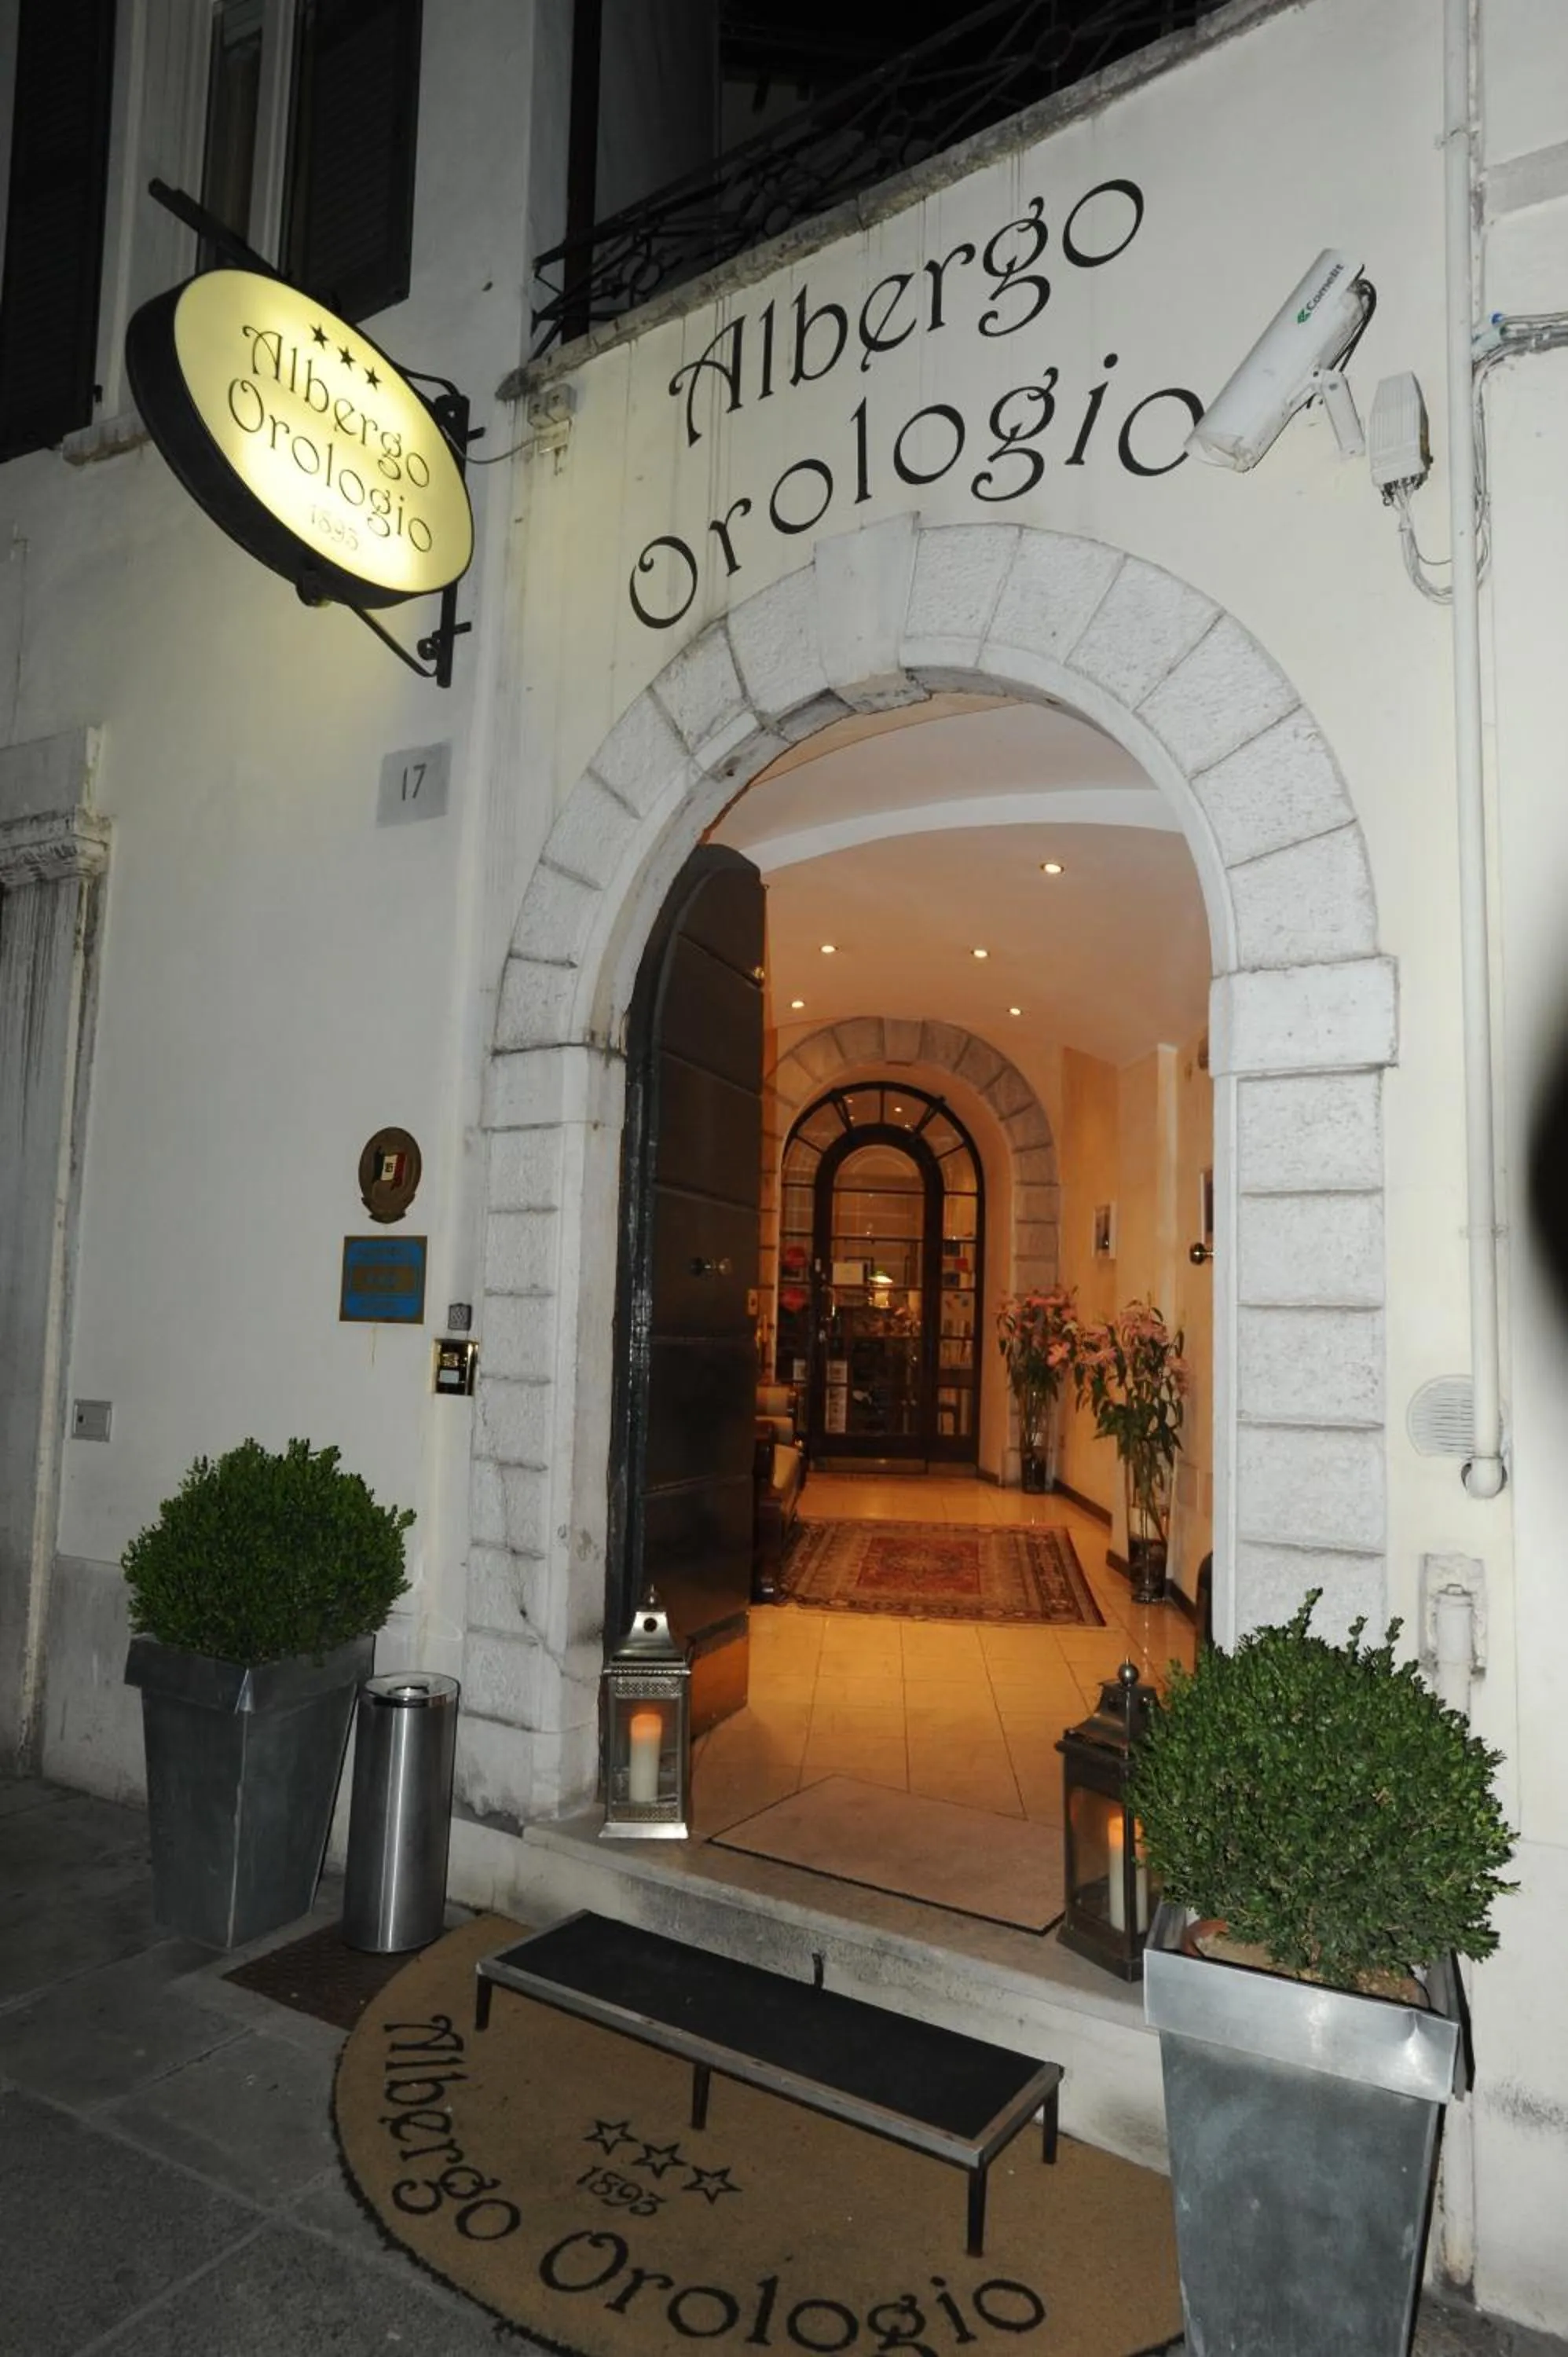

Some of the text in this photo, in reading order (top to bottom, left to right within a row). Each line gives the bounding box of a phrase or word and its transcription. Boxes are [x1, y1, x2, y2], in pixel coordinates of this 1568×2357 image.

[668, 179, 1145, 448] Albergo
[1306, 263, 1345, 312] Comelit
[228, 378, 433, 552] Orologio
[242, 325, 430, 489] Albergo
[629, 353, 1205, 629] Orologio
[401, 762, 427, 801] 17
[379, 2014, 1046, 2357] Albergo Orologio
[576, 2166, 666, 2216] 1893
